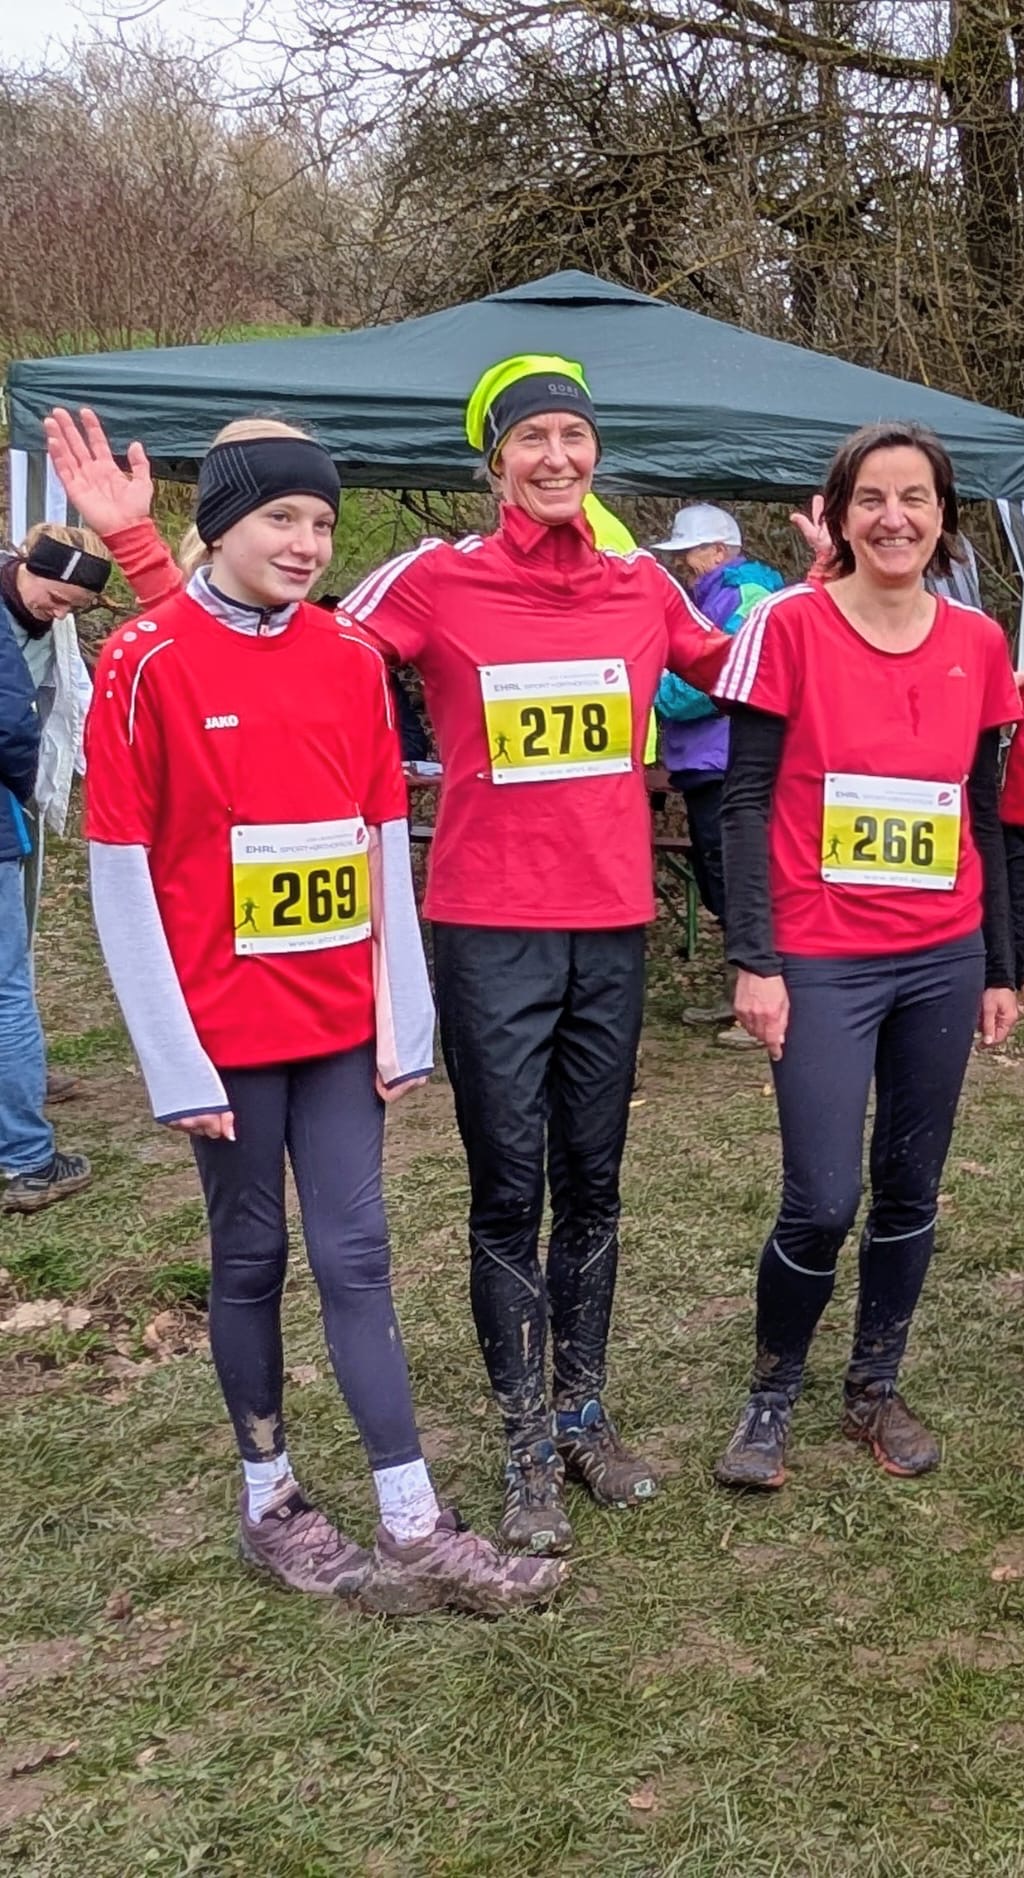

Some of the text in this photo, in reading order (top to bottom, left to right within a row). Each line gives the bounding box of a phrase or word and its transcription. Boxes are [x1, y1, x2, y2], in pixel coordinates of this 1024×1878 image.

[204, 714, 239, 729] JAKO
[520, 703, 609, 757] 278
[245, 844, 277, 854] EHRL
[852, 815, 934, 866] 266
[272, 865, 357, 927] 269
